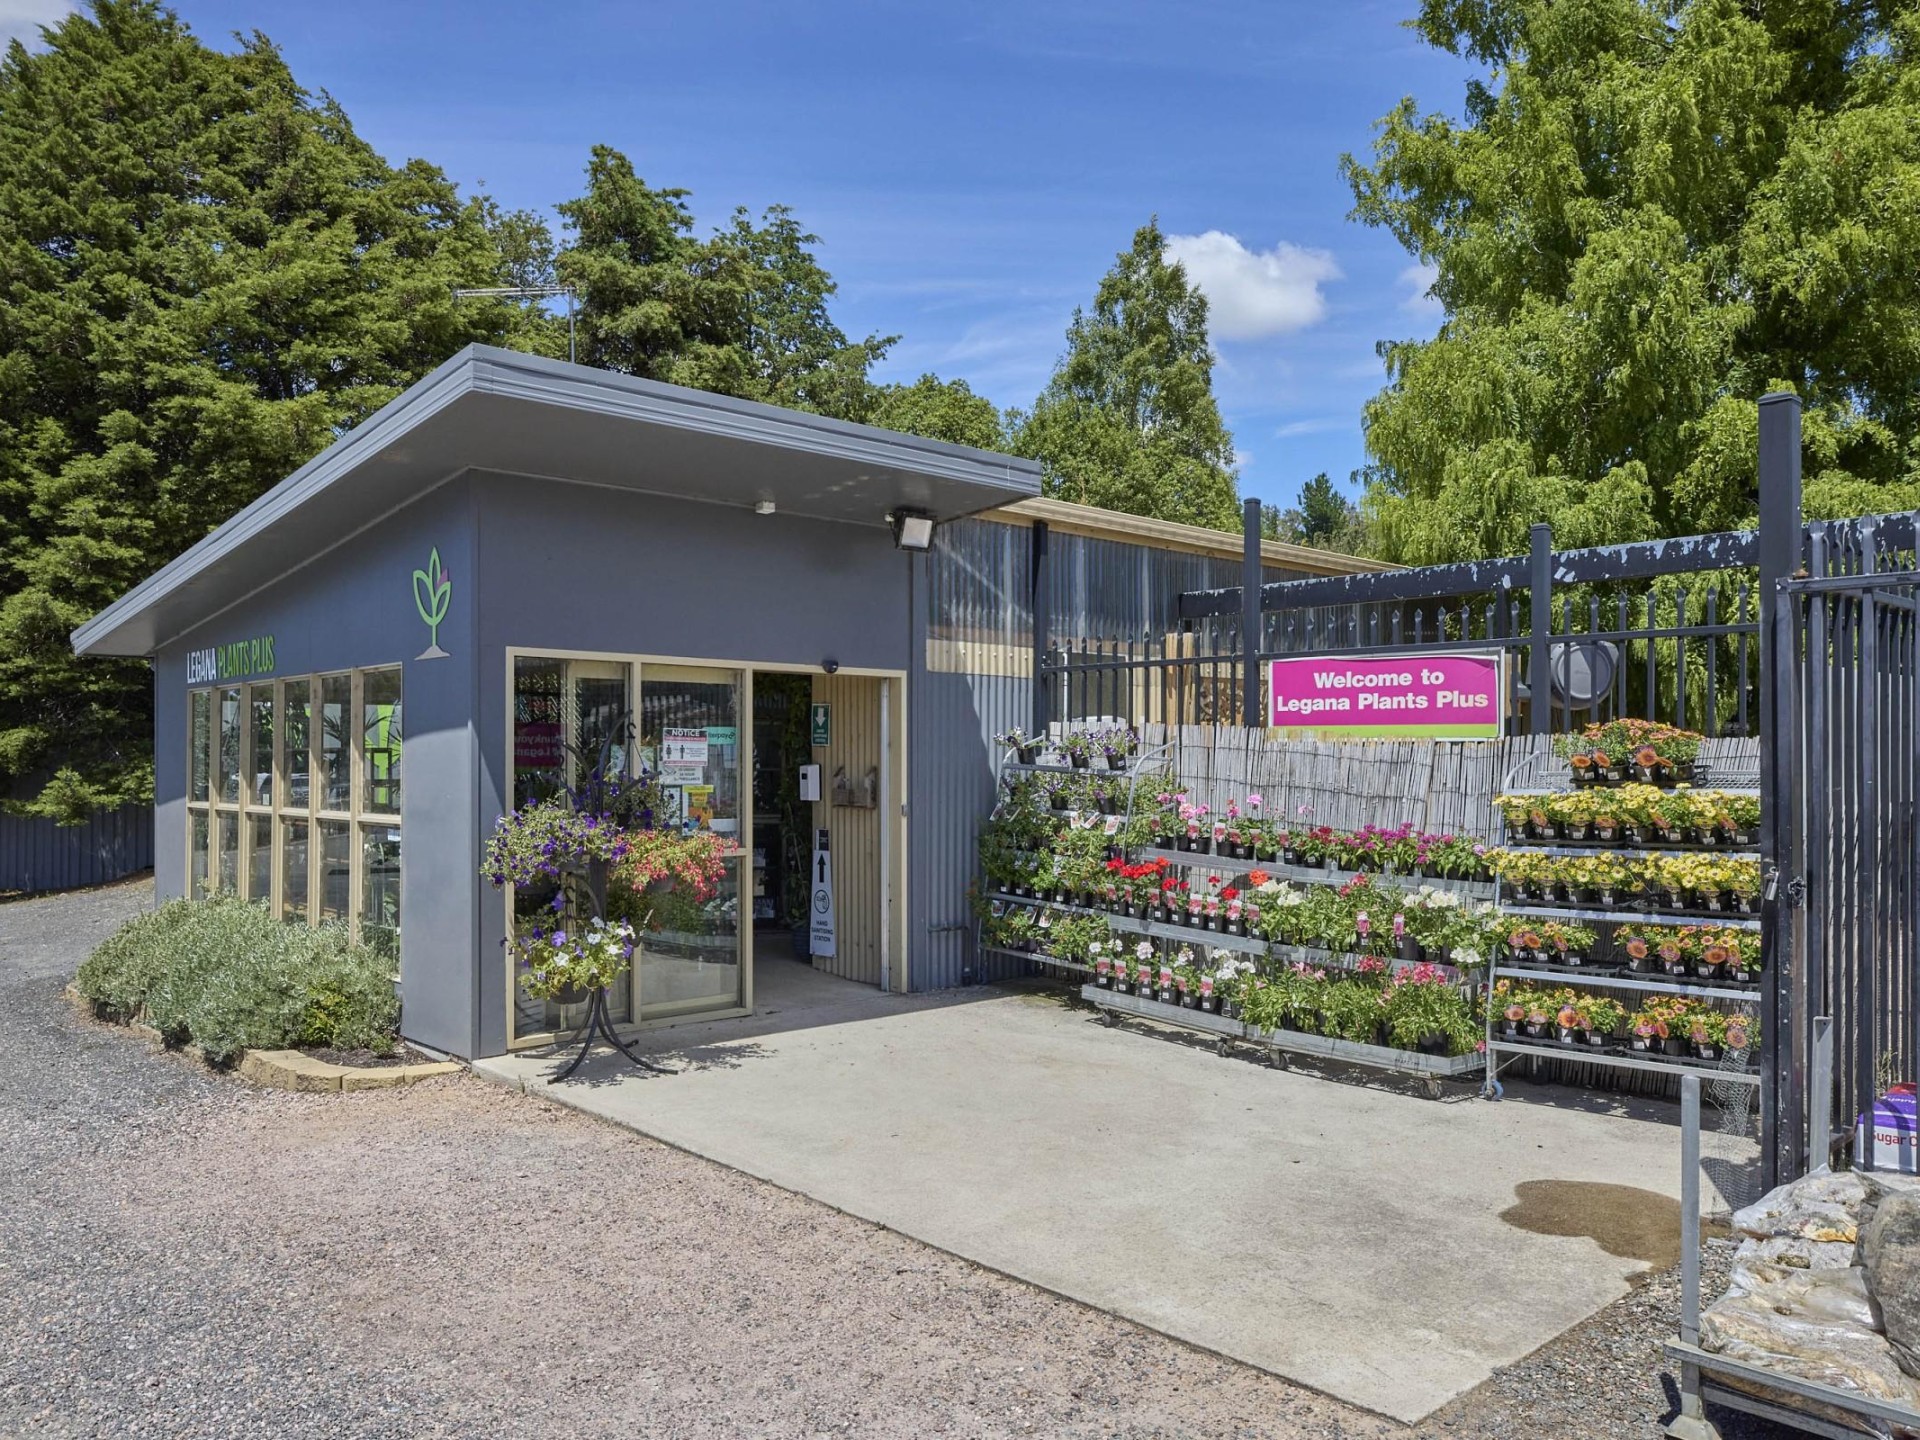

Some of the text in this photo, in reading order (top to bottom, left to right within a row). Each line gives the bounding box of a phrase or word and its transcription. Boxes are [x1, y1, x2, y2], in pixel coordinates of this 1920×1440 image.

[187, 635, 275, 683] LEGANA PLANTS PLUS
[1314, 669, 1445, 689] Welcome to
[1277, 690, 1489, 715] Legana Plants Plus
[671, 729, 700, 737] NOTICE
[814, 934, 831, 942] STATION
